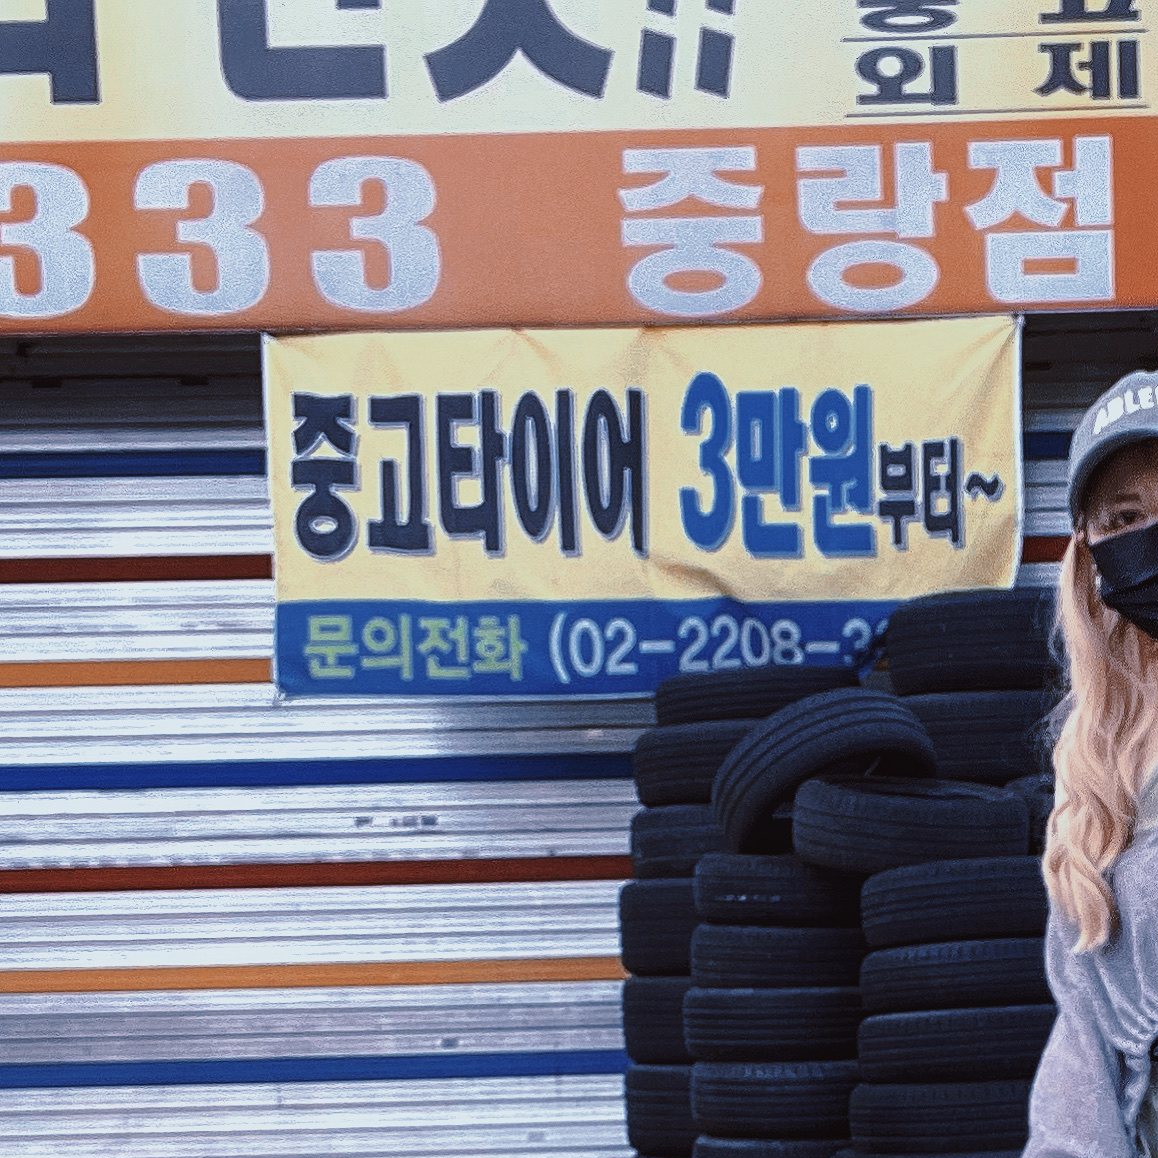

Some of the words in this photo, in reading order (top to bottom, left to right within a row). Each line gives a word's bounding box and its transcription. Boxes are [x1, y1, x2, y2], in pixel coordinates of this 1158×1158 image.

[617, 134, 1116, 316] 중랑점
[290, 387, 652, 562] 중고타이어
[303, 612, 529, 682] 문의전화
[549, 610, 888, 684] (02-2208-3
